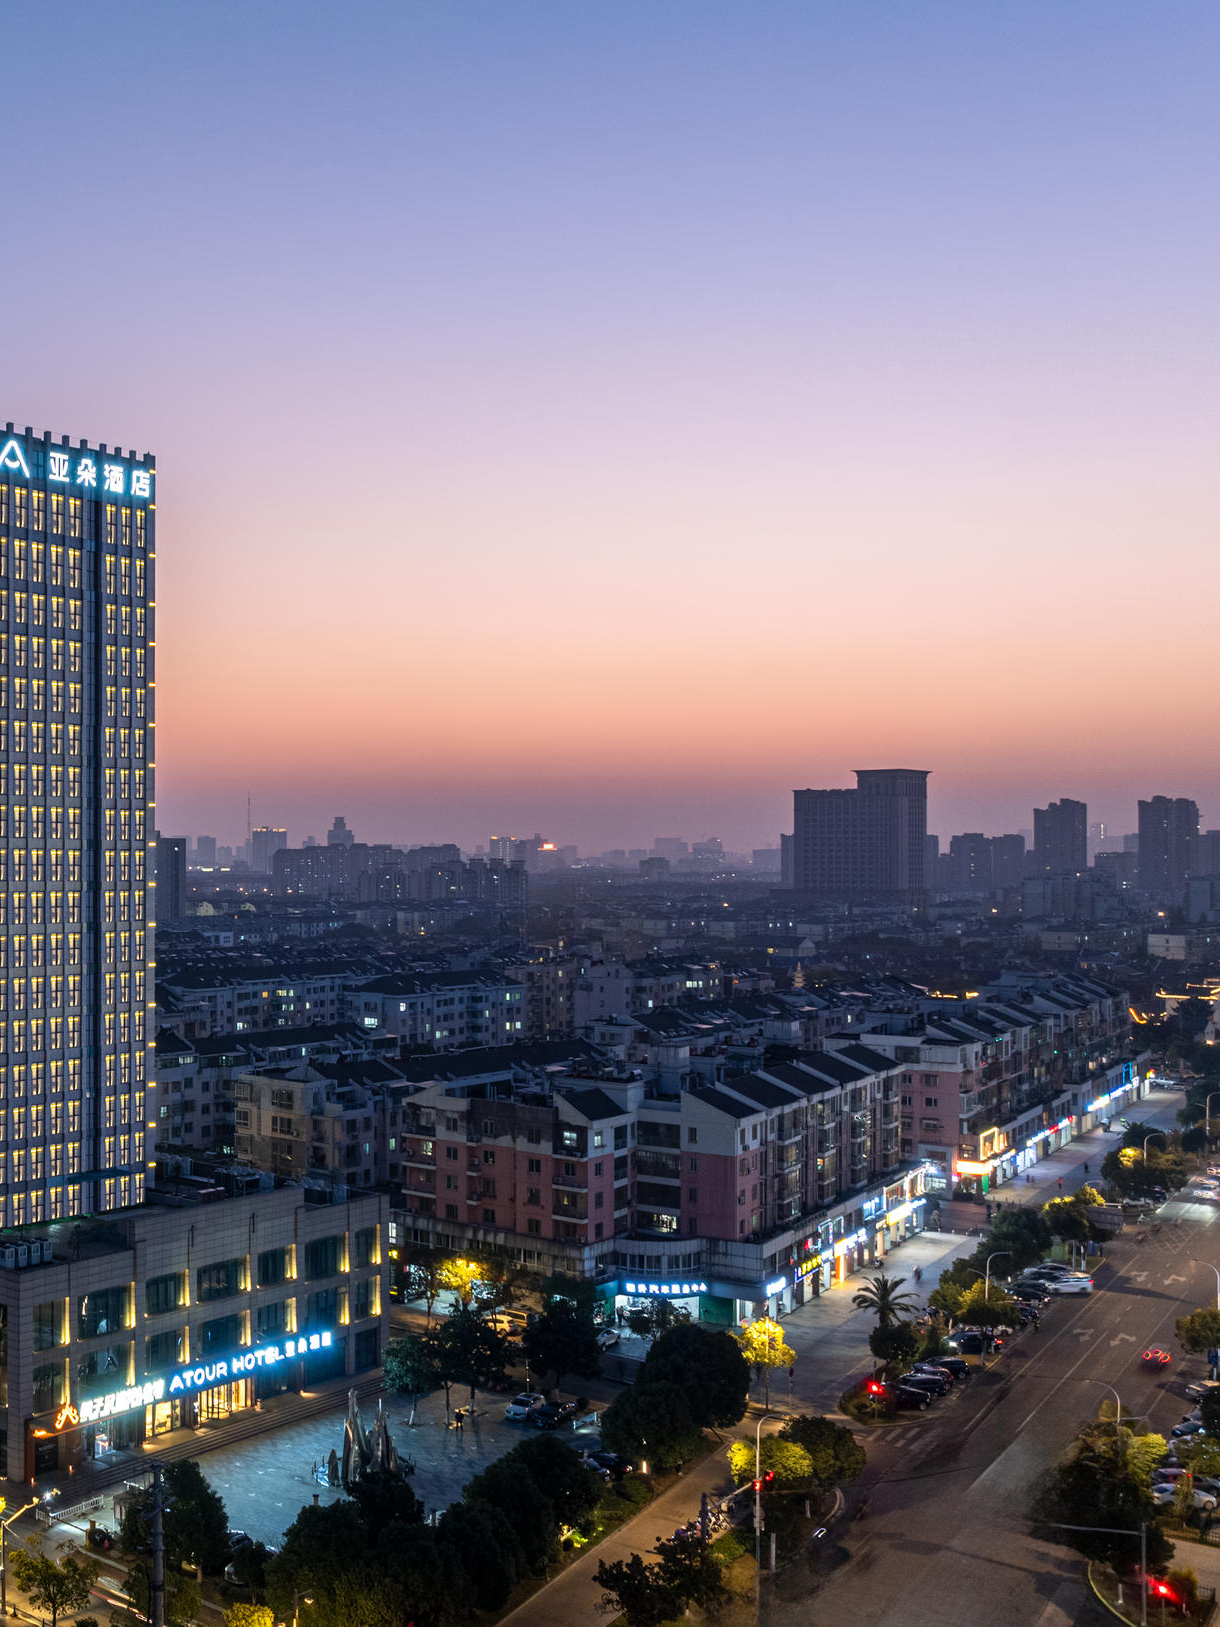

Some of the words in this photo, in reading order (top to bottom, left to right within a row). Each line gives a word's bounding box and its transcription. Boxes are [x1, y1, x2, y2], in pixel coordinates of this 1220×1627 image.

[48, 451, 150, 498] 亚朵酒店
[169, 1361, 228, 1393] ATOUR
[232, 1346, 285, 1374] HOTEL
